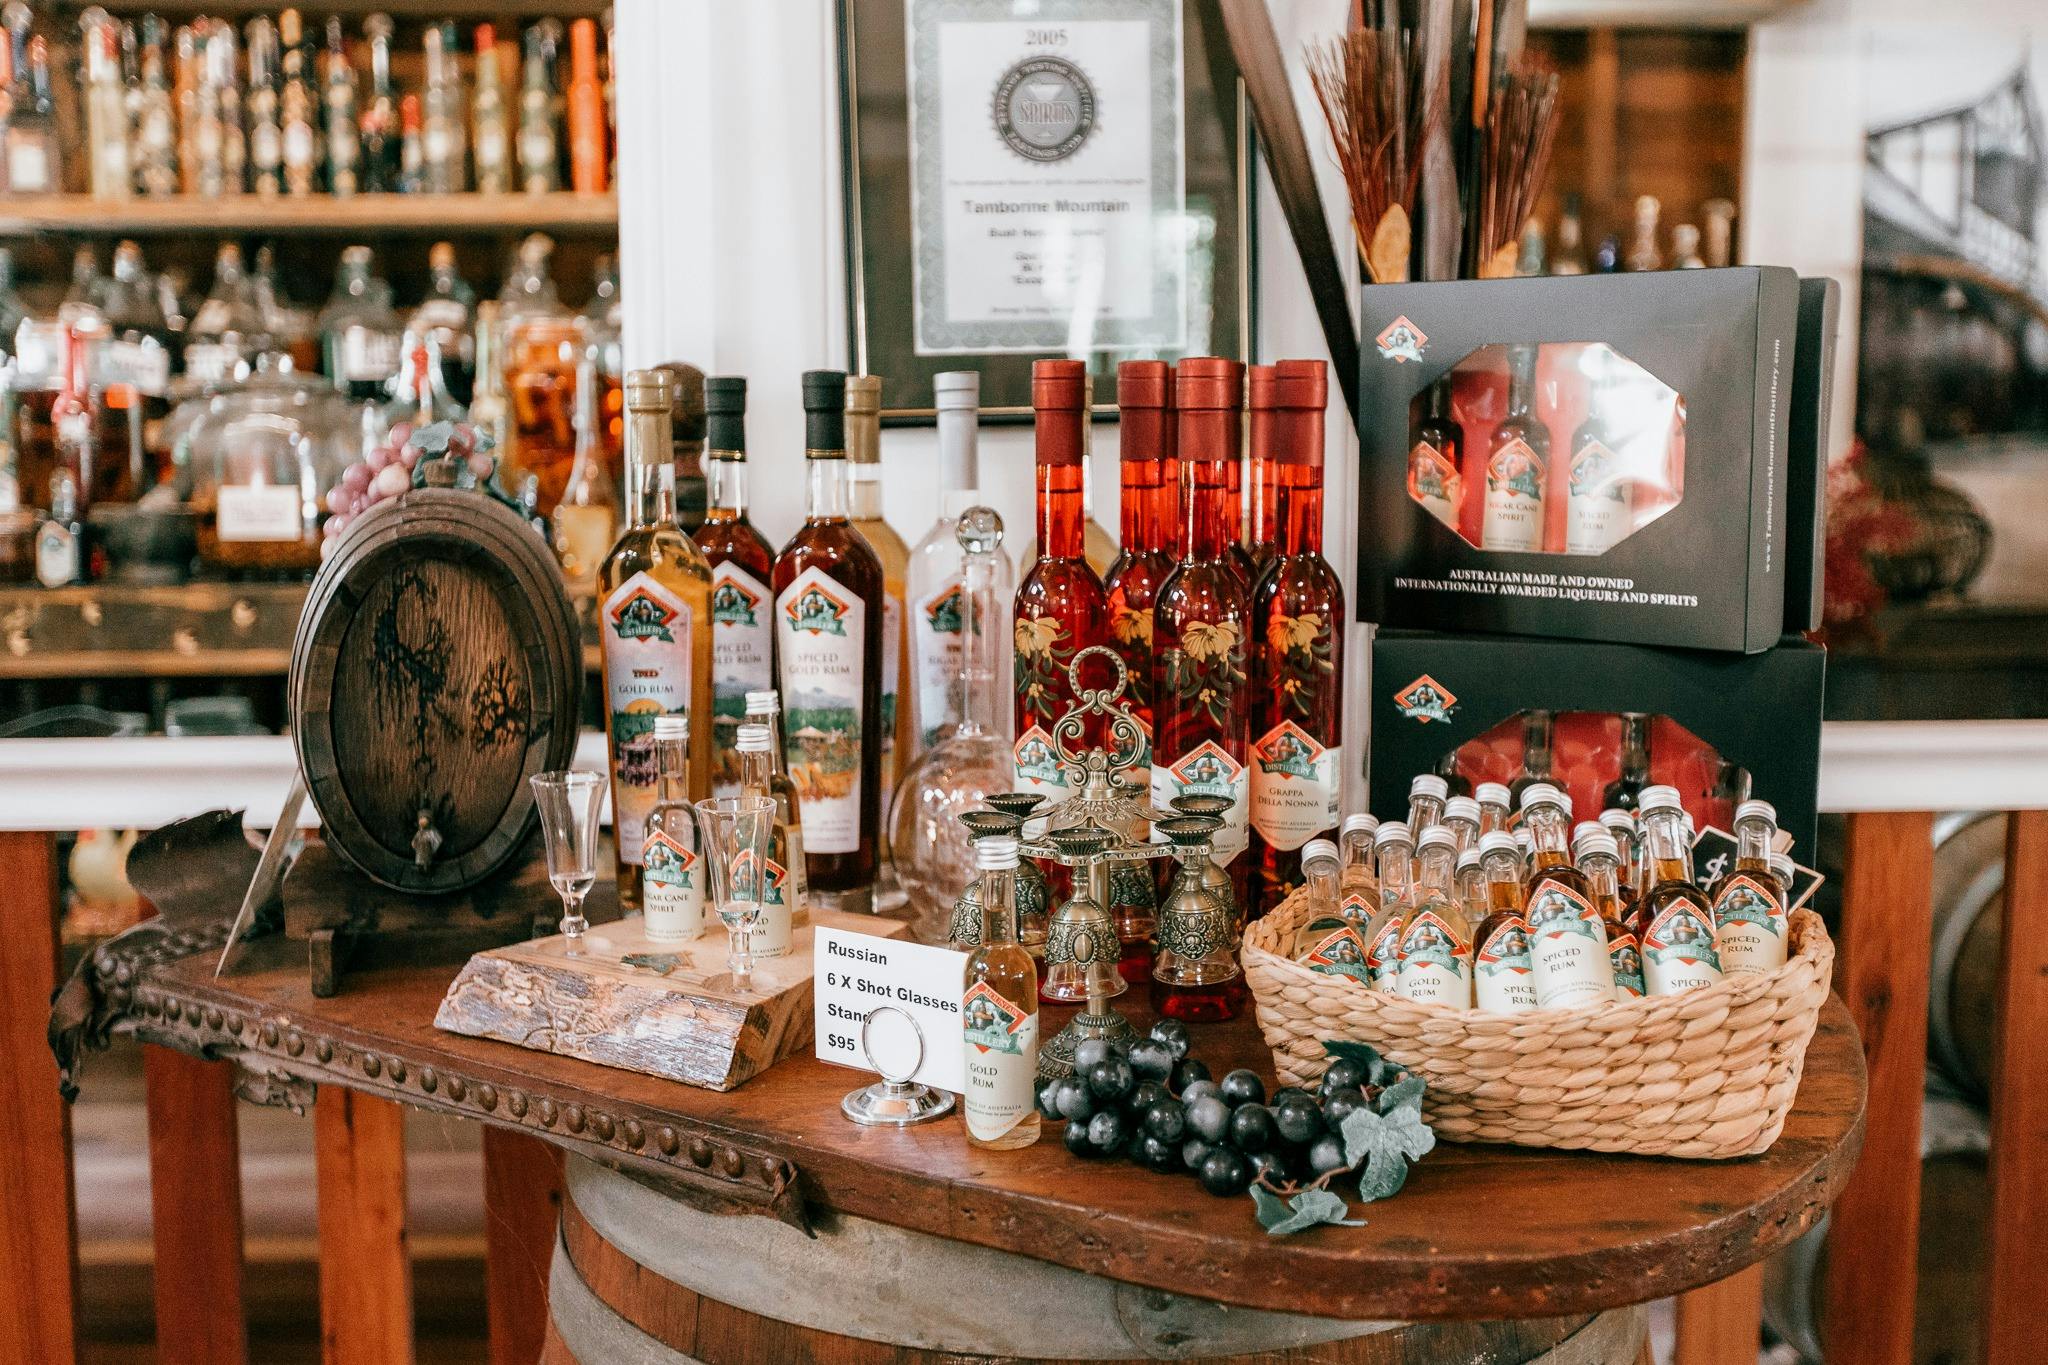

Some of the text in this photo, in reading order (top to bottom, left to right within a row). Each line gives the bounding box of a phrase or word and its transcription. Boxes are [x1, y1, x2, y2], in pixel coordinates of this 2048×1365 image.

[1023, 28, 1069, 46] 2005
[964, 199, 1130, 214] Tamborine Mountain
[1766, 339, 1780, 573] www.TamborineMountainDistillery.com
[1450, 569, 1634, 589] AUSTRALIAN MADE AND OWNED
[1394, 577, 1698, 607] INTERNATIONALLY AWARDED LIQUEURS AND SPIRITS
[716, 642, 752, 653] PICED
[798, 652, 839, 663] SPICED
[788, 665, 850, 674] GOLD RUM
[619, 685, 674, 694] GOLD RUM
[1265, 763, 1312, 776] DISTILLERY
[1182, 783, 1231, 795] DISTILLERY
[1269, 786, 1304, 797] GRAPPA
[1257, 795, 1319, 808] DELLA NONNA
[664, 893, 689, 901] CANE
[650, 904, 674, 913] SPIRIT
[1721, 935, 1761, 945] SPICED
[828, 941, 887, 965] Russian
[1727, 945, 1754, 954] RUM
[1543, 947, 1581, 965] SPICED
[1550, 961, 1576, 974] RUM
[1409, 977, 1441, 988] GOLD
[827, 972, 836, 986] 6
[841, 975, 851, 989] X
[857, 978, 892, 998] Shot
[897, 987, 958, 1013] Glasses
[1411, 989, 1436, 998] RUM
[1503, 985, 1537, 995] SPICE
[1512, 995, 1538, 1006] RUM
[828, 1033, 855, 1051] $95
[970, 1062, 998, 1077] GOLD
[972, 1076, 995, 1089] RUM
